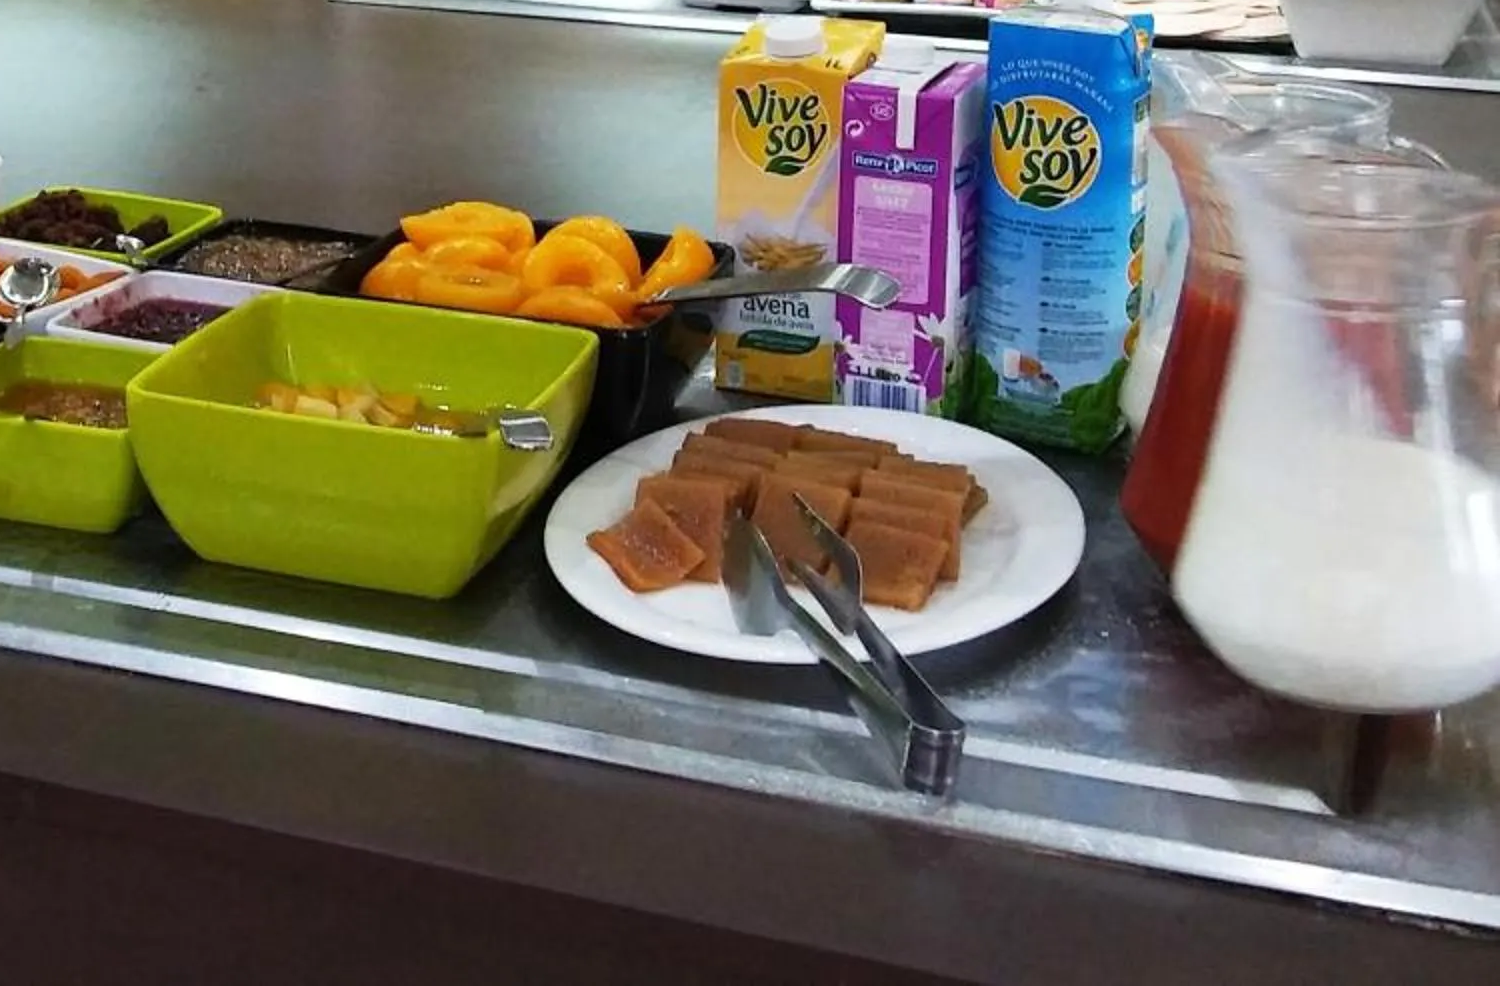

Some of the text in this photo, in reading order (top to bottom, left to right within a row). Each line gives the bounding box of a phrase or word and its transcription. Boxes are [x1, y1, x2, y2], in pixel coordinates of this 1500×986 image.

[735, 83, 820, 129] Vive
[993, 100, 1090, 151] Vive
[764, 123, 828, 163] soy
[1020, 147, 1098, 194] soy
[743, 294, 811, 320] avena
